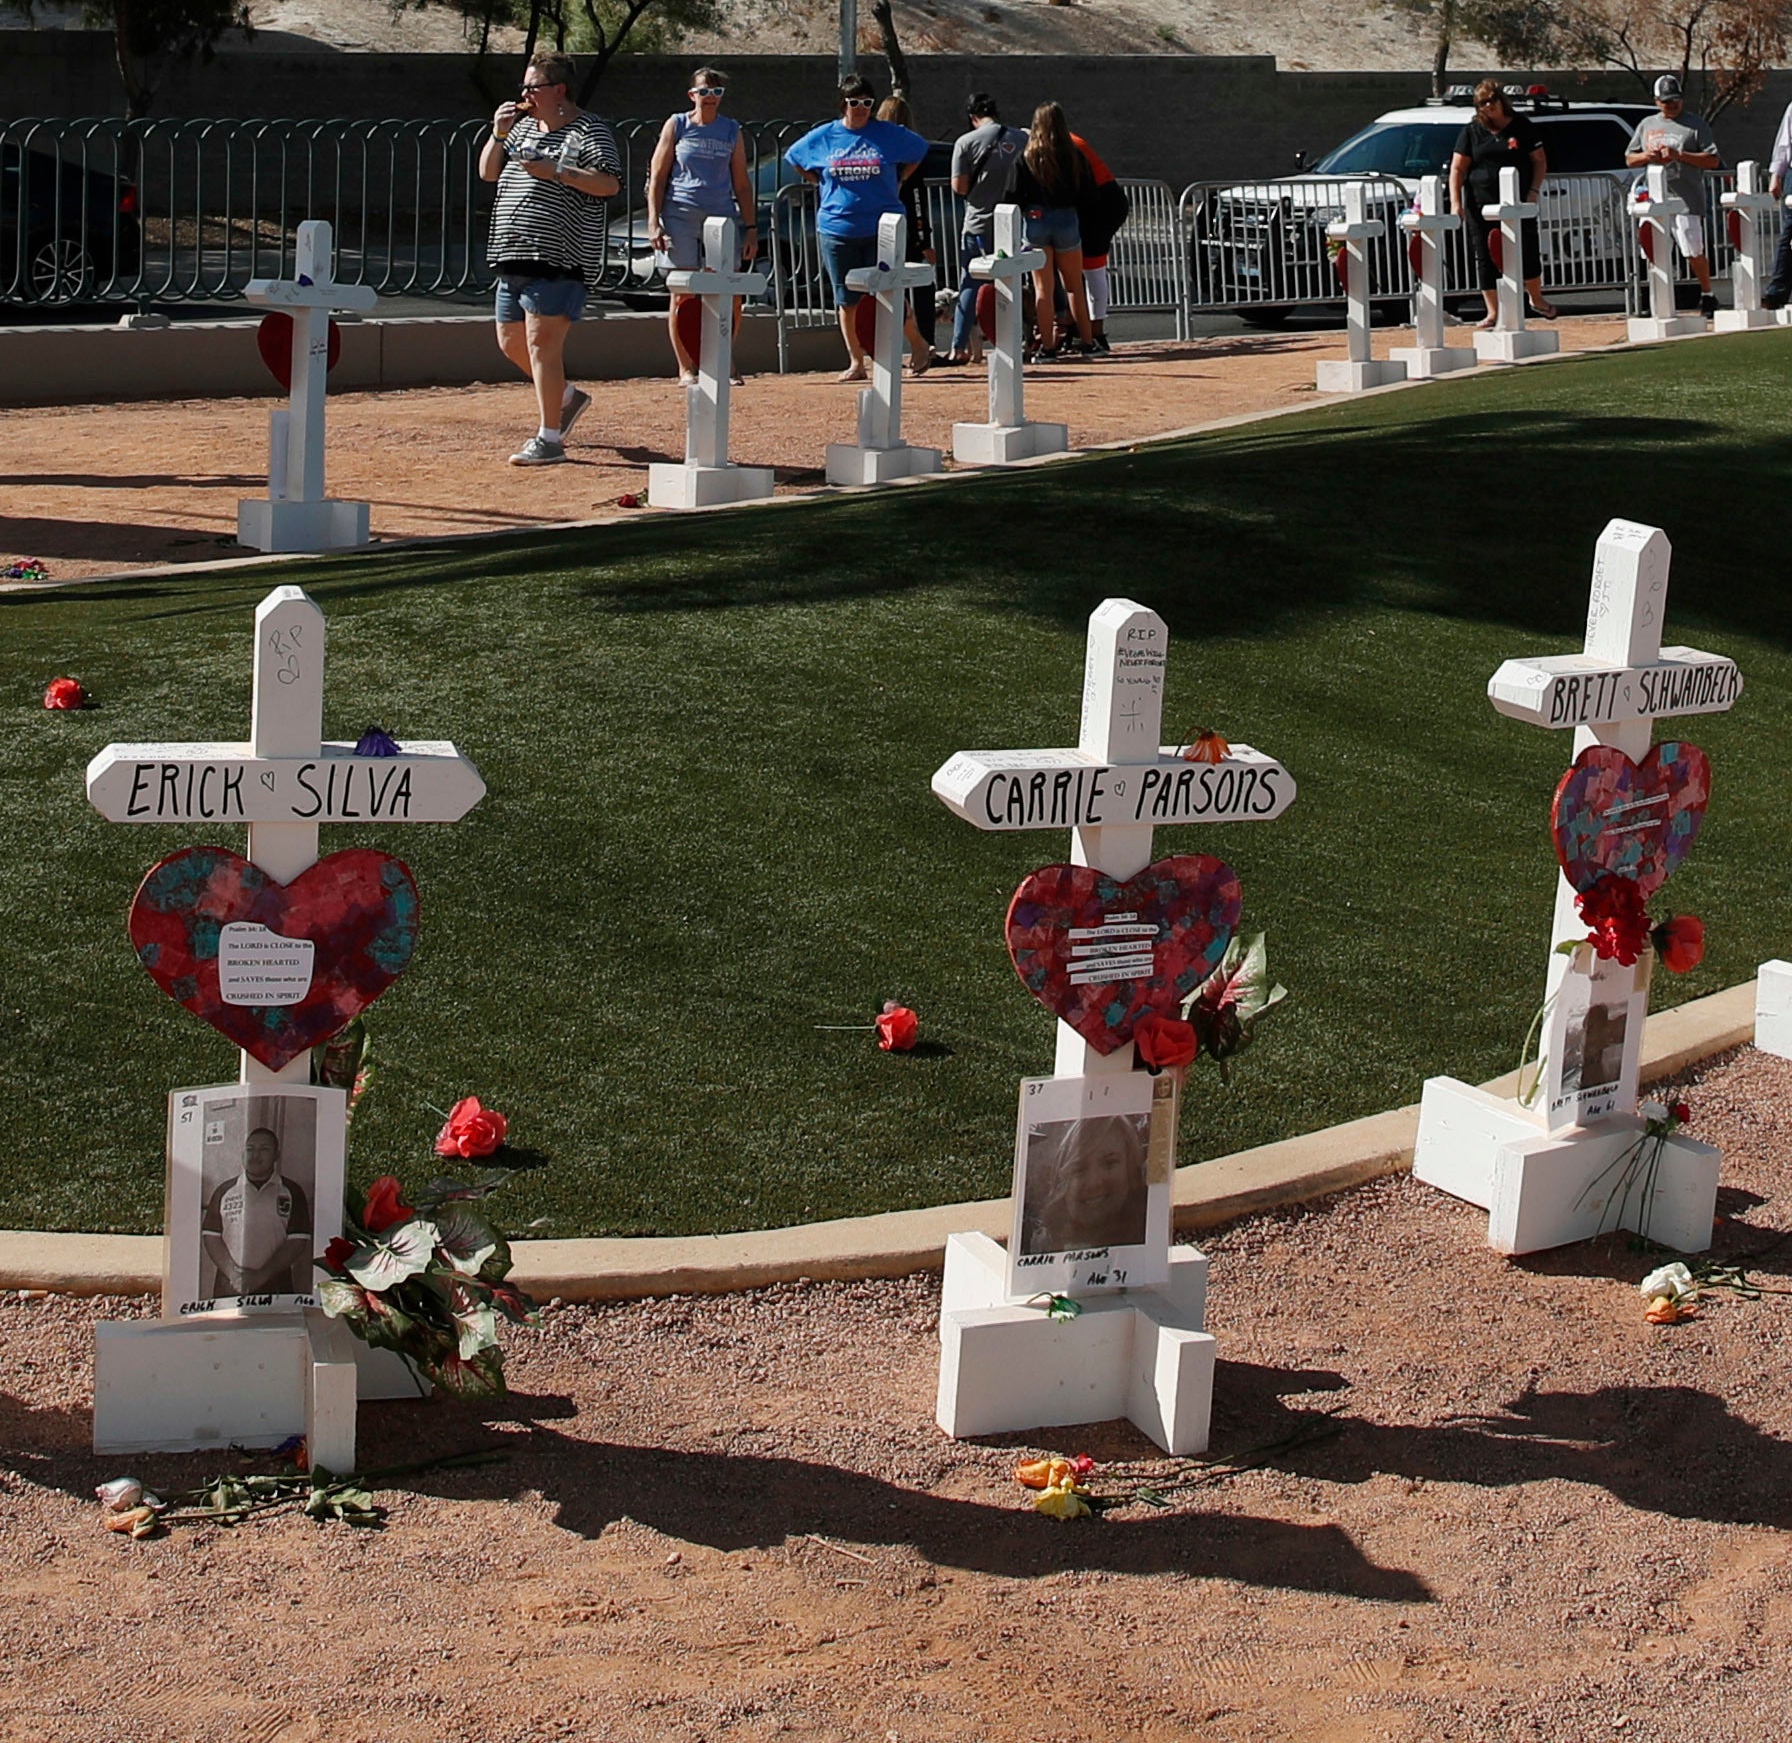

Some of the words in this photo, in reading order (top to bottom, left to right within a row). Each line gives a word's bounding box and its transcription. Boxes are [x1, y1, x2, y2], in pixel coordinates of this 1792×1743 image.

[829, 166, 880, 176] STRONG
[1550, 673, 1622, 723] BRETT
[1637, 665, 1738, 714] SCHWANBECK
[127, 763, 245, 818] ERICK
[291, 763, 412, 818] SILVA
[986, 768, 1109, 827] CARRIE
[1135, 768, 1281, 821] PARSONS
[1119, 943, 1151, 951] HEARTED
[1088, 972, 1121, 982] CRUSHED
[1028, 1084, 1044, 1095] 37
[1017, 1253, 1055, 1268] CARRIE
[1063, 1248, 1109, 1264] PARSONS
[1113, 1269, 1127, 1284] 31
[180, 1299, 217, 1315] ERICK
[236, 1294, 273, 1307] SILVA
